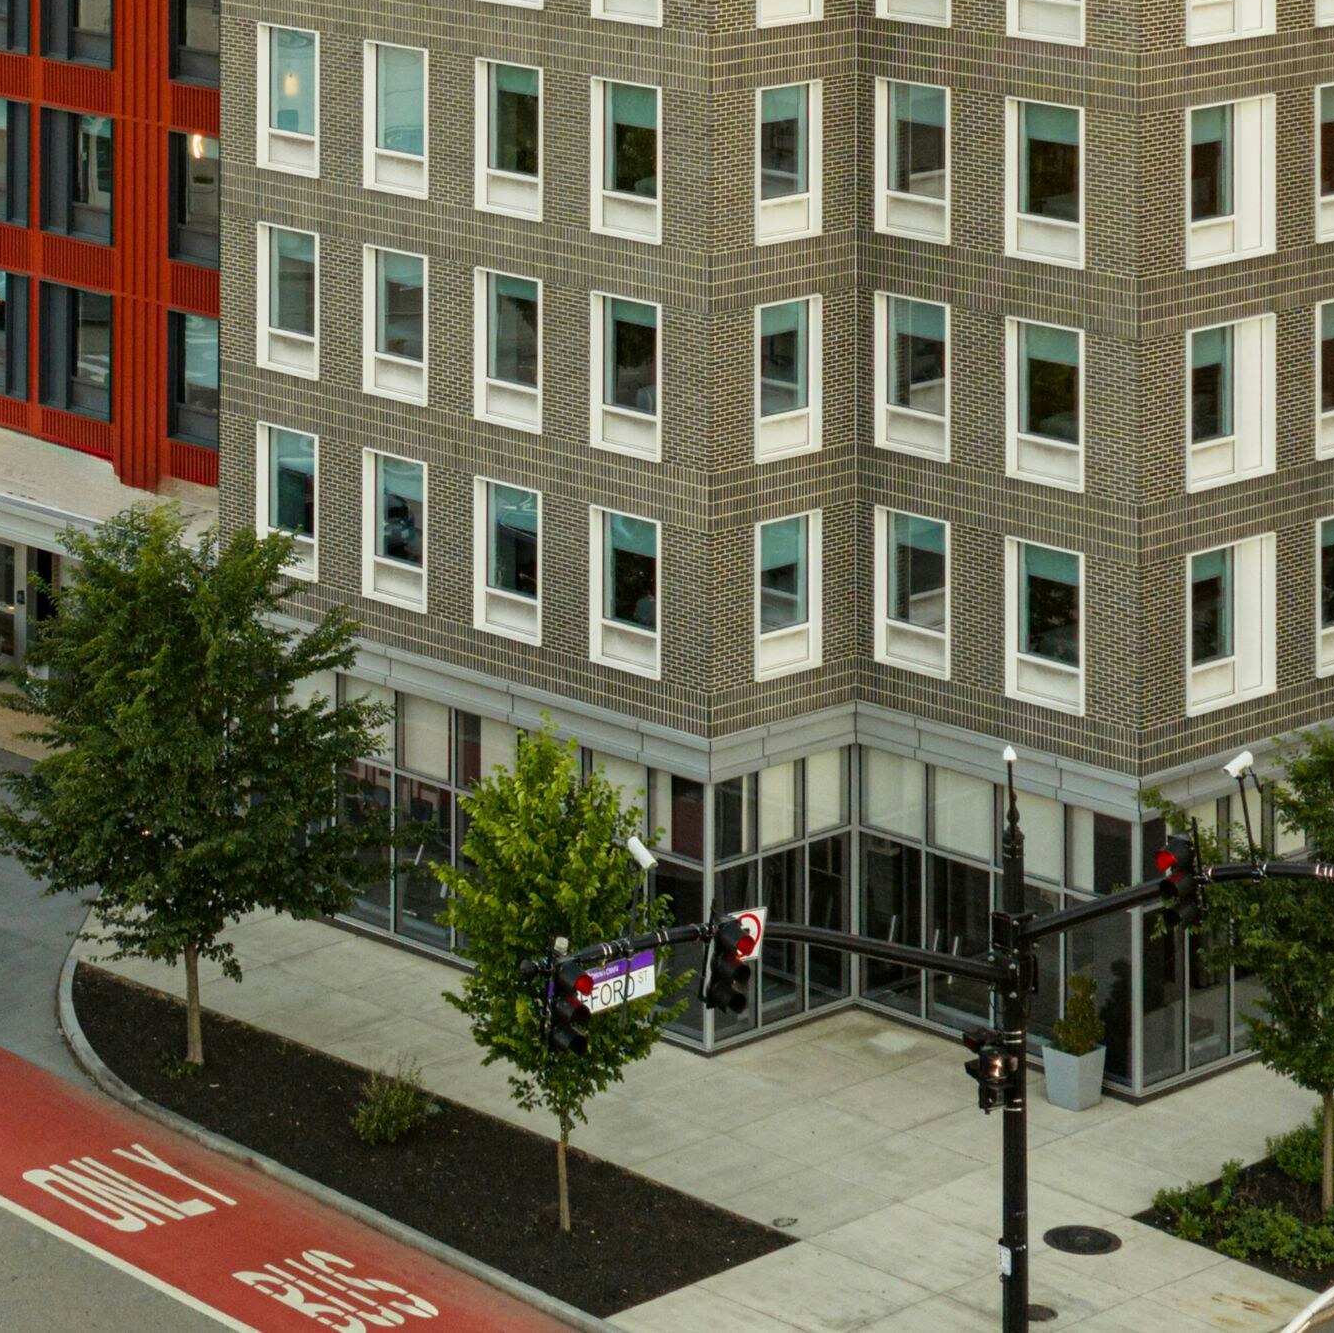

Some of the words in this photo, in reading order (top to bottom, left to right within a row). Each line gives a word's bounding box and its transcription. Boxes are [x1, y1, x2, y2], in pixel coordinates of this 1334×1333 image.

[637, 969, 648, 984] ST
[22, 1143, 238, 1232] ONLY
[231, 1249, 439, 1333] BUS
